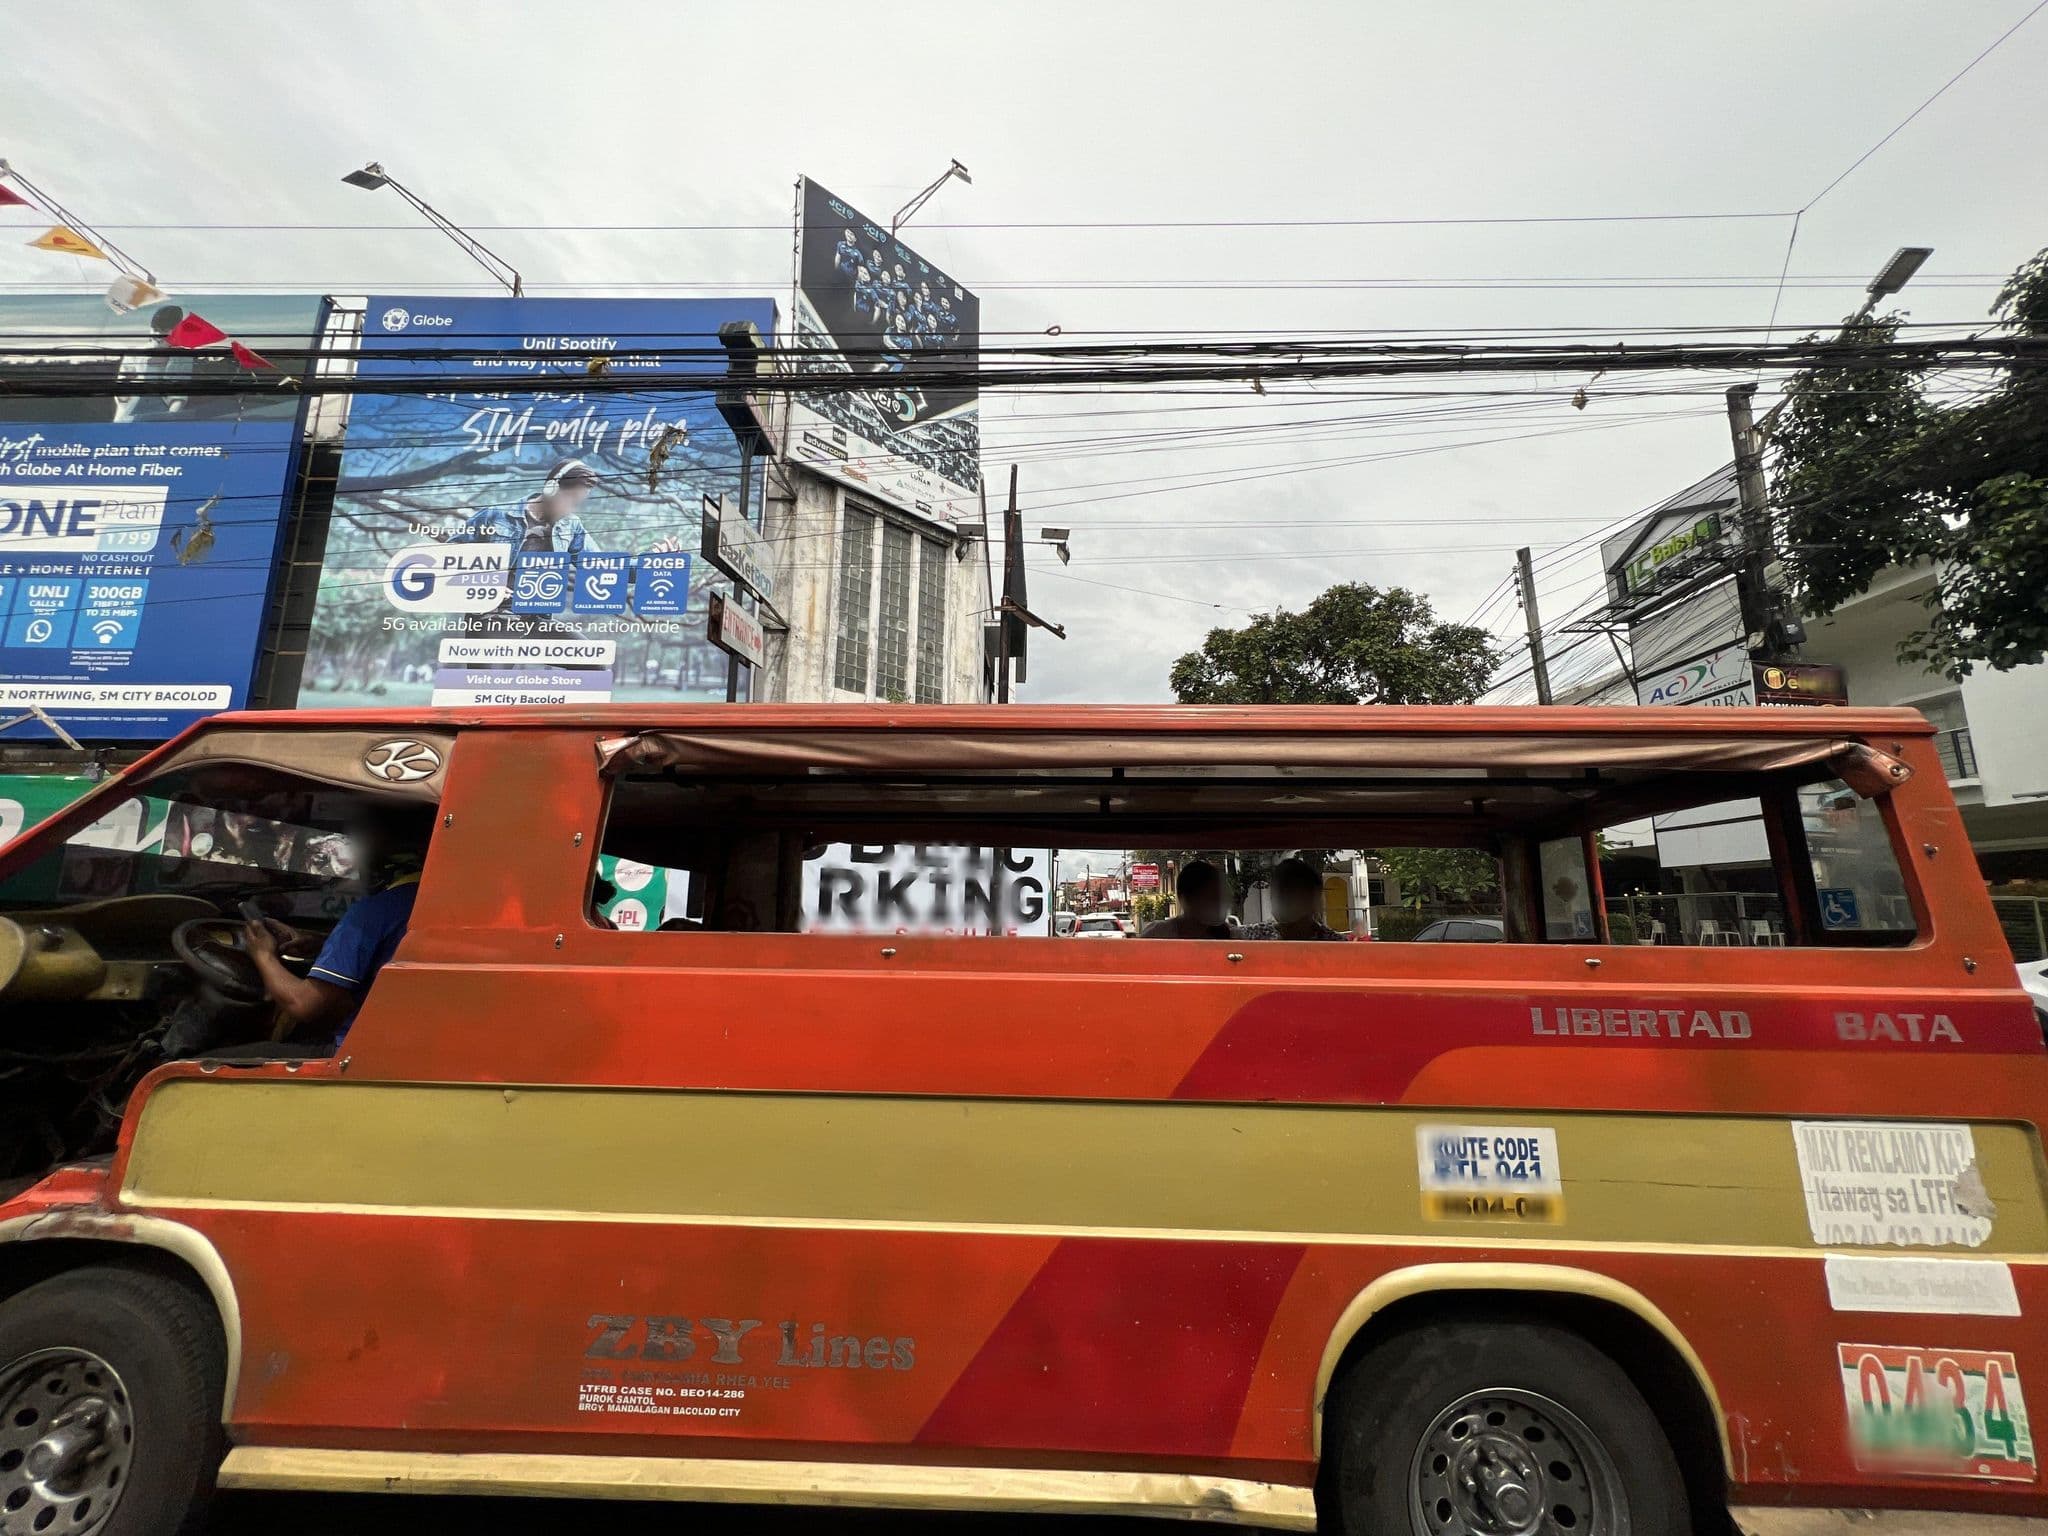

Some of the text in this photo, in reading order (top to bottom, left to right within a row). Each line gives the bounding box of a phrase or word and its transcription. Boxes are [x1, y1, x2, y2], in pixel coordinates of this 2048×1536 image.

[412, 314, 454, 326] Globe
[523, 337, 617, 351] Unli Spotify
[507, 358, 536, 370] way
[462, 406, 610, 456] SIM-only
[35, 444, 91, 457] mobile
[93, 444, 129, 459] plan
[133, 443, 166, 456] that
[168, 445, 222, 457] comes
[15, 462, 62, 476] Globe
[65, 463, 84, 476] At
[87, 464, 136, 476] Home
[140, 464, 184, 477] Fiber.
[102, 499, 156, 520] Plan
[408, 523, 497, 538] Upgrade to
[106, 532, 151, 545] 1799
[82, 554, 155, 563] NO CASH OUT
[443, 556, 502, 571] PLAN
[522, 556, 564, 569] UNLI
[582, 557, 625, 570] UNLI
[642, 557, 685, 570] 20GB
[30, 565, 73, 575] HOME
[78, 565, 152, 576] INTERNET
[461, 574, 500, 584] PLUS
[516, 571, 563, 600] 5G
[28, 585, 70, 598] UNLI
[88, 586, 143, 599] 300GB
[465, 587, 498, 600] 999
[86, 609, 98, 617] TO
[112, 609, 138, 617] MBPS
[382, 617, 680, 636] 5G available in key areas nationwide
[449, 645, 605, 658] Now with NO LOCKUP
[466, 675, 582, 685] Visit our Globe Store
[8, 690, 95, 702] NORTHWING,
[99, 691, 119, 701] SM
[122, 691, 151, 701] CITY
[155, 691, 218, 701] BACOLOD
[474, 694, 565, 706] SM City Bacolod
[1529, 1007, 1964, 1043] LIBERTAD BATA
[1494, 1137, 1540, 1161] CODE
[1803, 1129, 1841, 1172] MAY
[1843, 1130, 1931, 1174] REKLAMO
[1886, 1185, 1911, 1214] sa
[584, 1314, 915, 1370] ZBY Lines
[579, 1384, 617, 1394] LTFRB
[620, 1386, 653, 1396] CASE
[655, 1388, 676, 1397] NO.
[579, 1394, 656, 1406] PUROK SANTOL
[578, 1403, 741, 1417] BRGY. MANDALAGAN BACOLOD CITY
